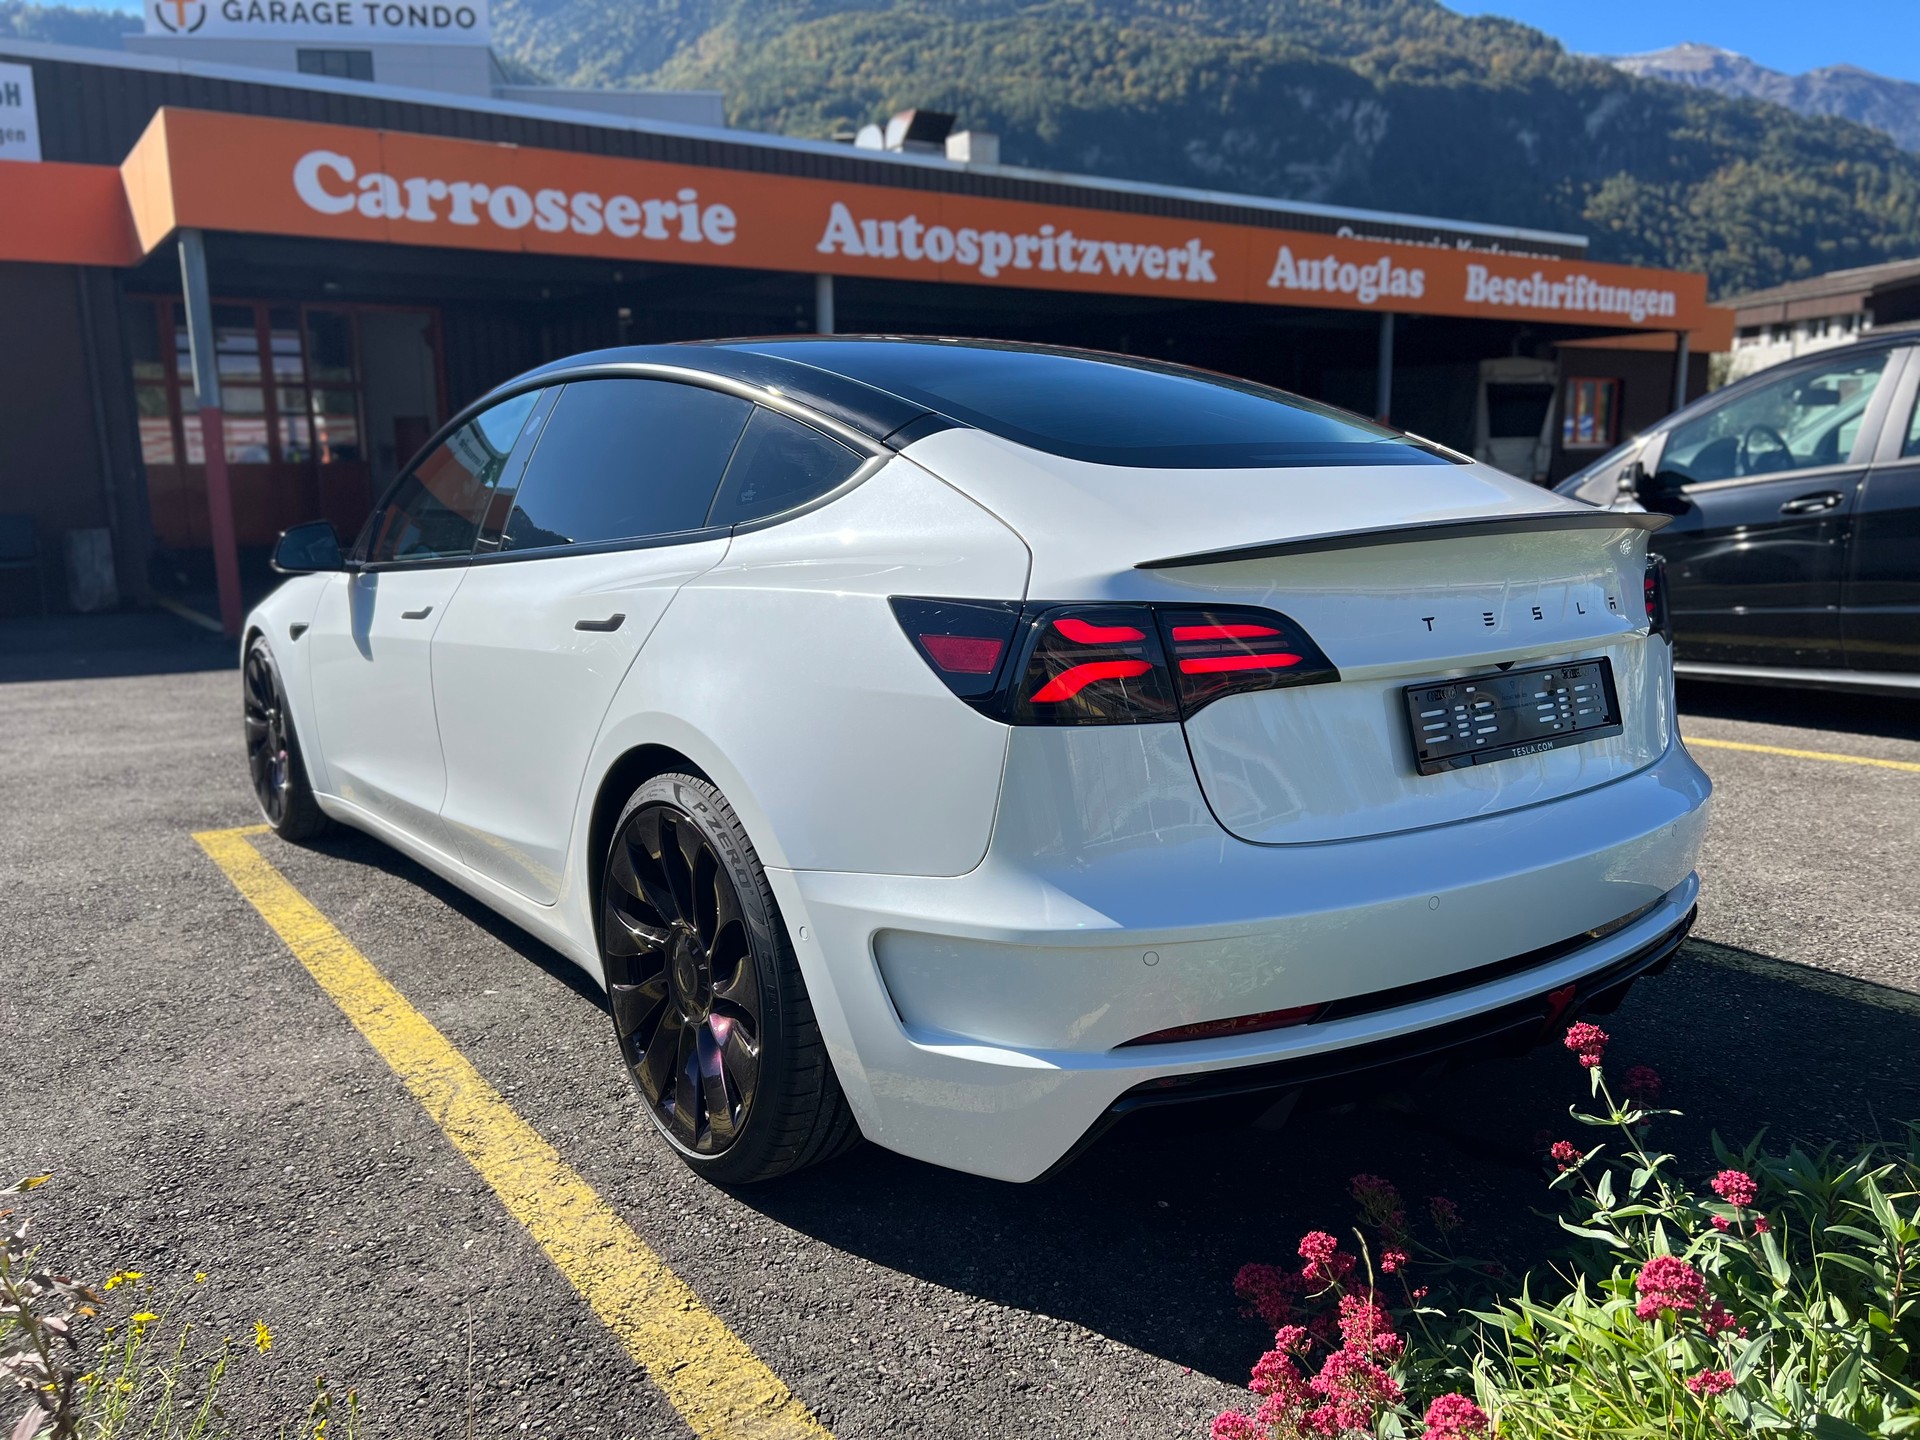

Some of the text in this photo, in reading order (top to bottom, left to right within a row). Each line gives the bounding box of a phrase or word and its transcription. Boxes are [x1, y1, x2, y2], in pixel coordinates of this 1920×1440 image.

[222, 0, 477, 30] GARAGE TONDO
[293, 149, 1677, 323] Carrosserie Autospritzwerk Autoglas Beschriftungen
[1421, 597, 1617, 632] TESLA
[1512, 742, 1554, 757] TESLA.COM
